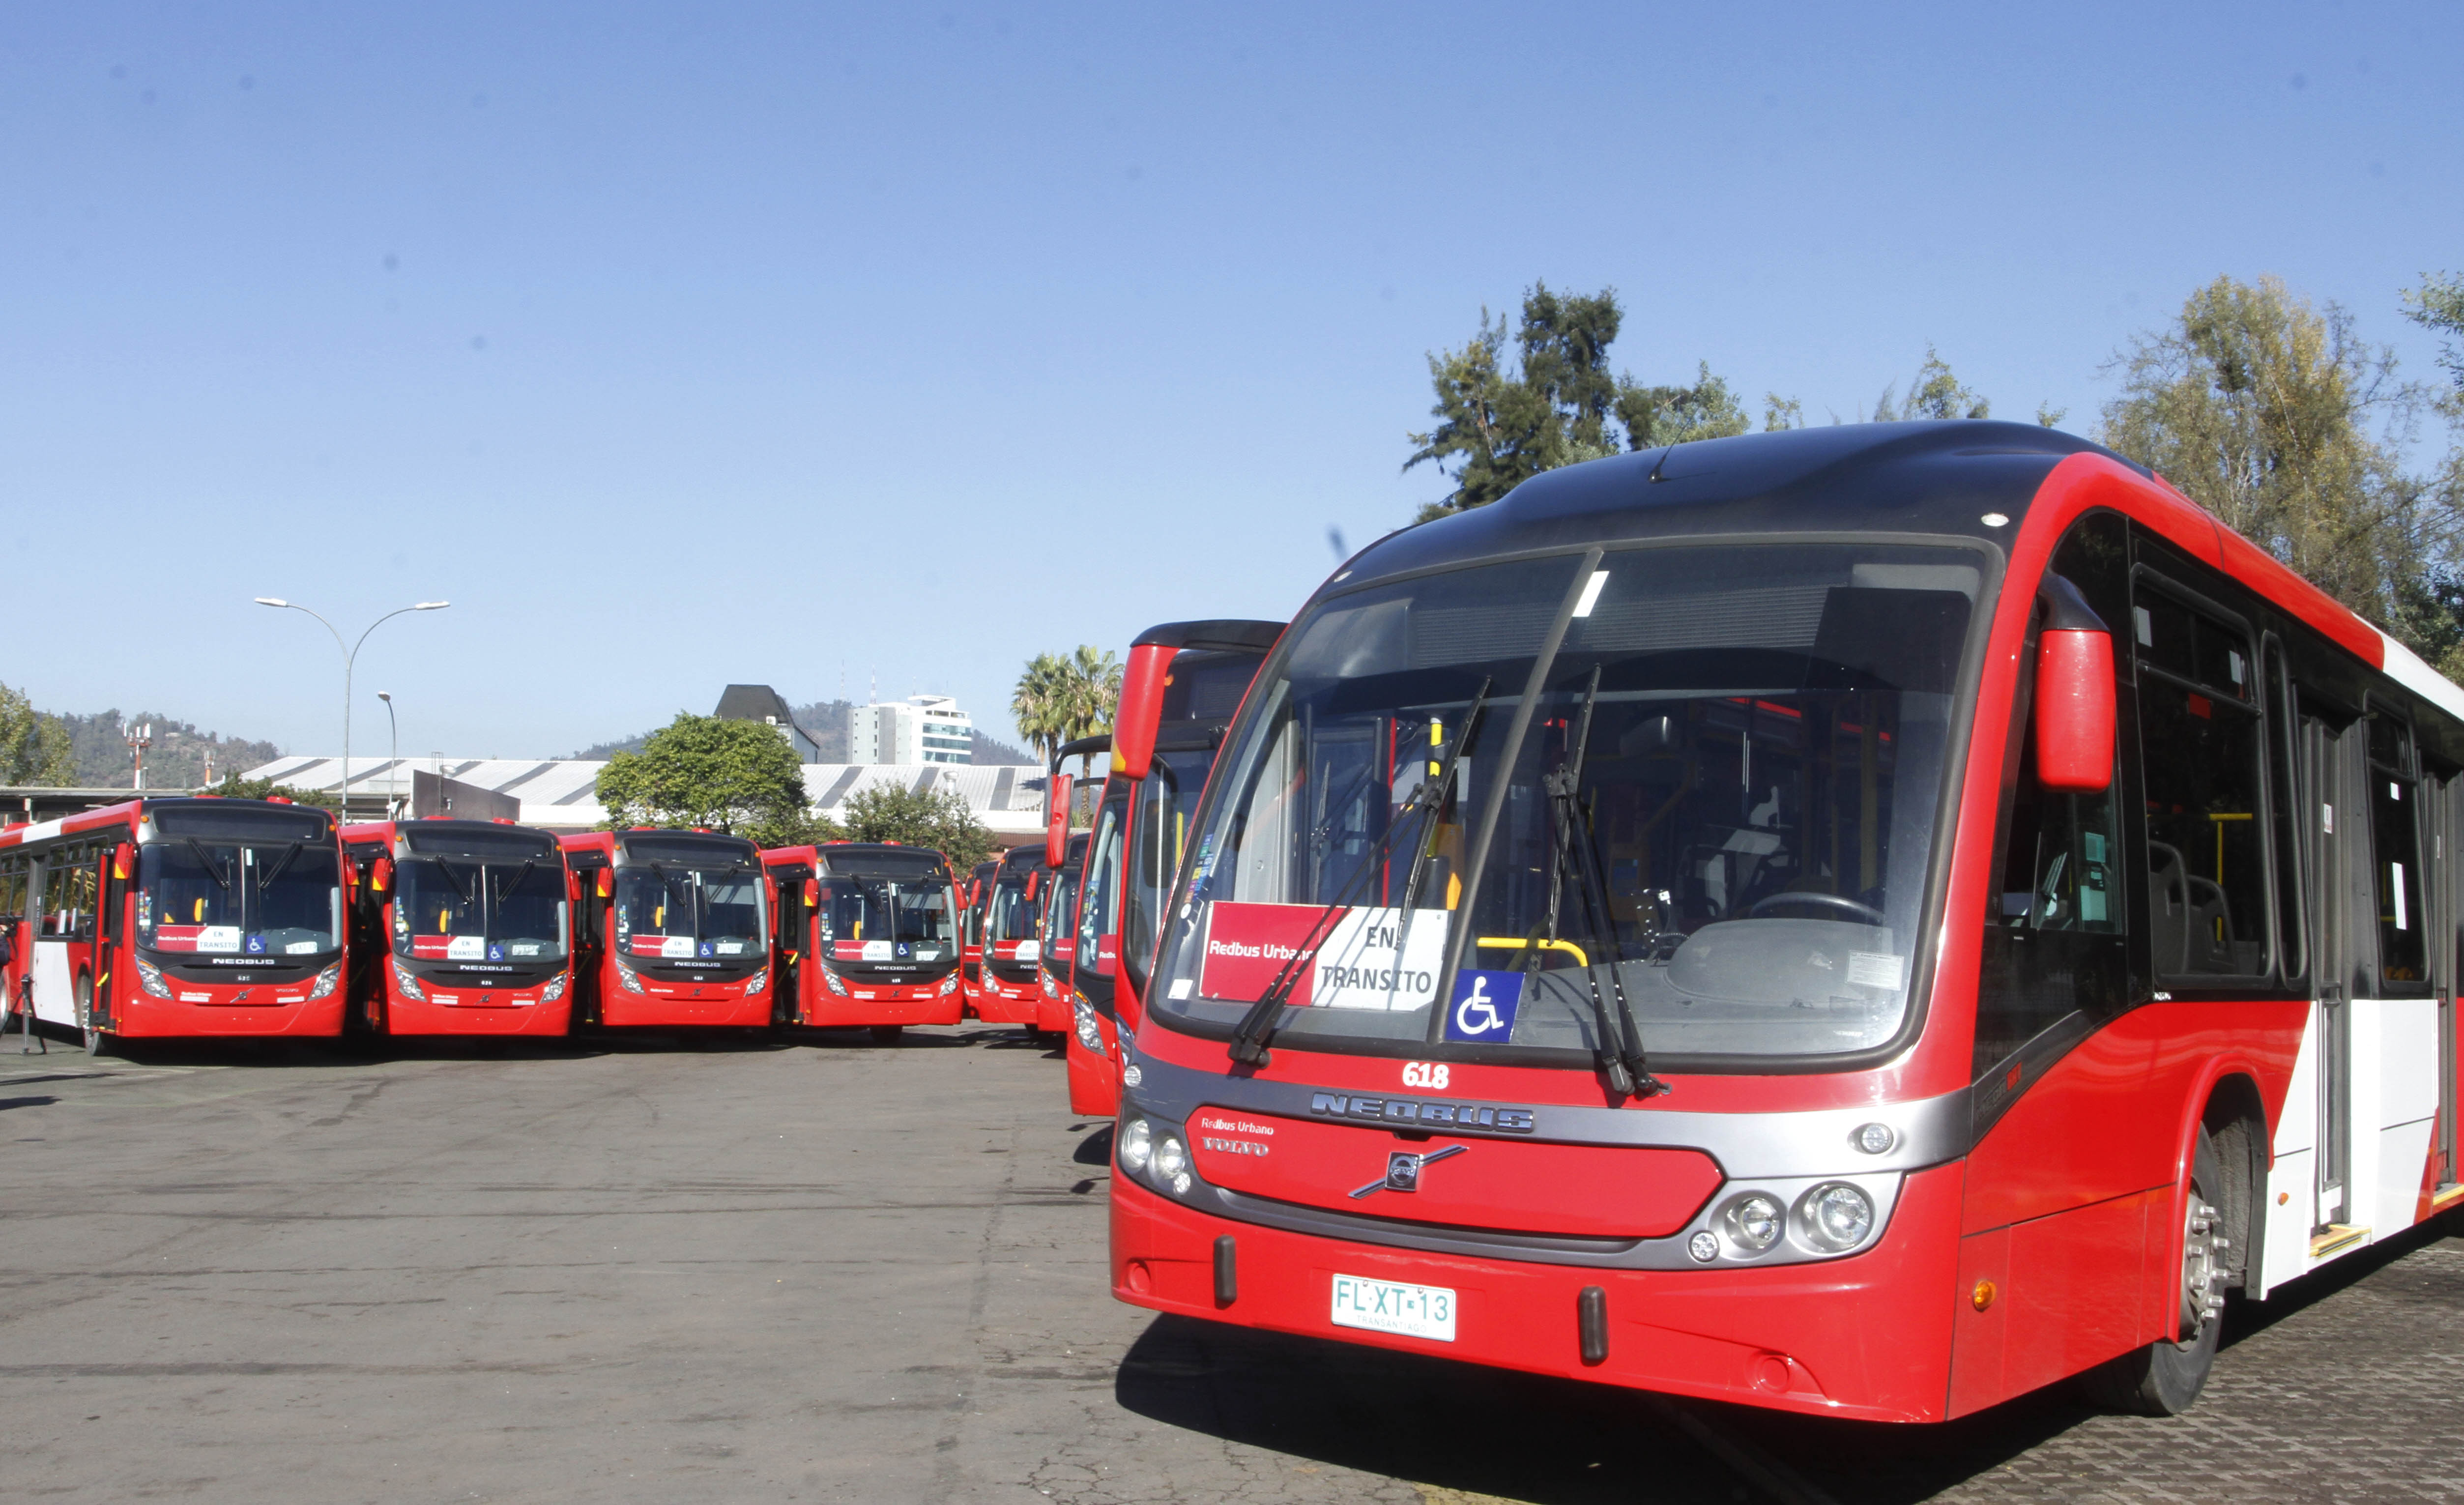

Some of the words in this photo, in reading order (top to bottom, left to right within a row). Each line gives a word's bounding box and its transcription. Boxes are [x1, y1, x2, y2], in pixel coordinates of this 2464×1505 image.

[1365, 926, 1395, 948] EN
[1210, 940, 1260, 957] Redbus
[1322, 966, 1431, 994] TRANSITO
[1402, 1062, 1449, 1089] 618
[1311, 1092, 1534, 1133] NEOBUS
[1202, 1117, 1236, 1131] Redbus
[1238, 1121, 1274, 1135] Urbano
[1202, 1136, 1269, 1157] VOLVO
[1357, 1315, 1427, 1333] TRANSANTIAGO
